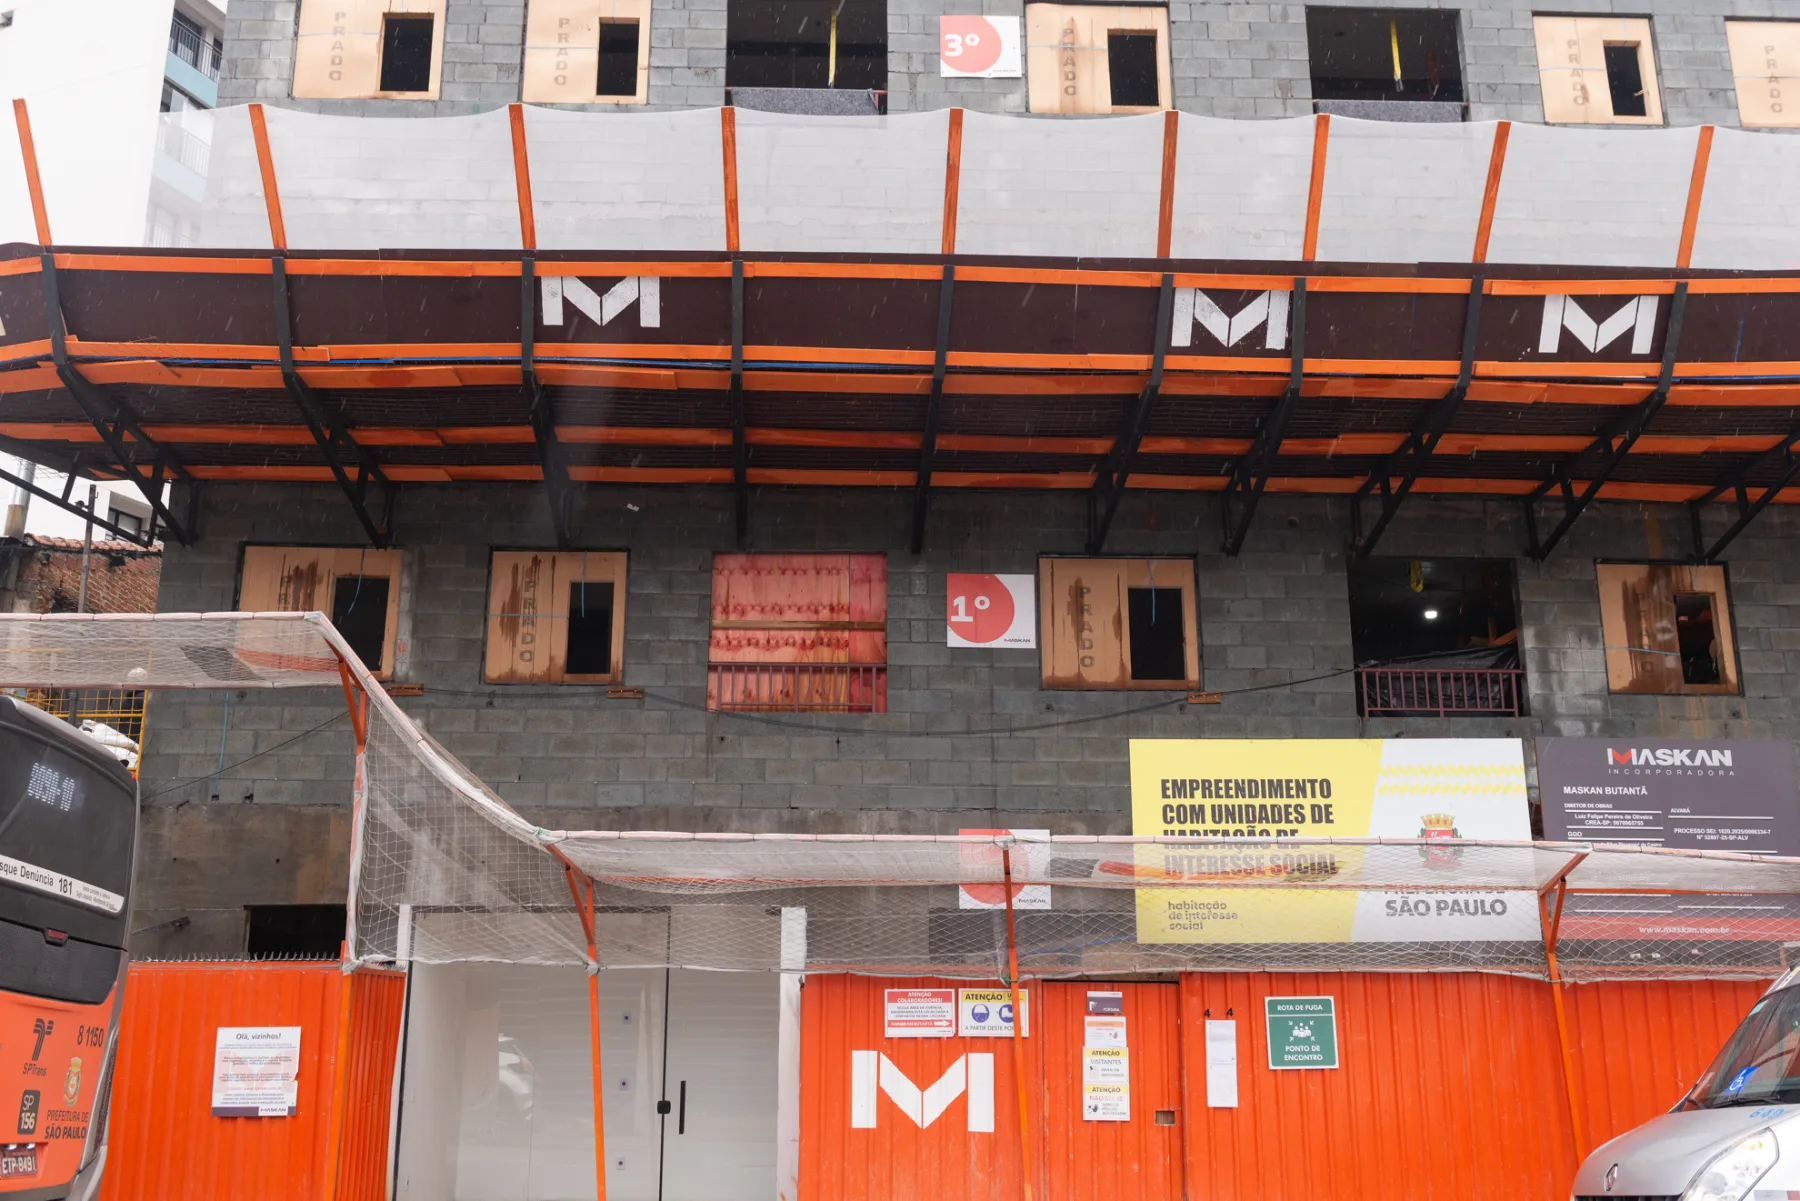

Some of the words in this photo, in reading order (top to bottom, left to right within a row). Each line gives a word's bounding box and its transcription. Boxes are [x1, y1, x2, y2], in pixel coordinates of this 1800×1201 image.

[1606, 747, 1733, 767] MASKAN
[1608, 768, 1735, 777] INCORPORADORA
[1160, 778, 1332, 799] EMPREENDIMENTO
[1563, 785, 1603, 795] MASKAN
[1604, 785, 1648, 796] BUTANTÃ
[1162, 803, 1207, 825] COM
[1210, 803, 1306, 825] UNIDADES
[1310, 803, 1335, 825] DE
[1164, 853, 1266, 876] INTERESSE
[1268, 853, 1341, 876] SOCIAL
[20, 865, 54, 887] Denúncia
[58, 877, 74, 896] 181
[1167, 899, 1228, 911] habitação
[1385, 895, 1431, 917] SÃO
[1435, 898, 1508, 917] PAULO
[76, 1024, 85, 1046] 8
[85, 1025, 105, 1048] 1150
[235, 1032, 250, 1041] Olá,
[251, 1032, 282, 1040] vizinhos!
[22, 1094, 35, 1112] SP
[20, 1112, 36, 1130] 156
[46, 1109, 81, 1122] PREFEITURA
[82, 1111, 89, 1123] DE
[44, 1122, 62, 1140] SÃO
[62, 1125, 87, 1140] PAULO
